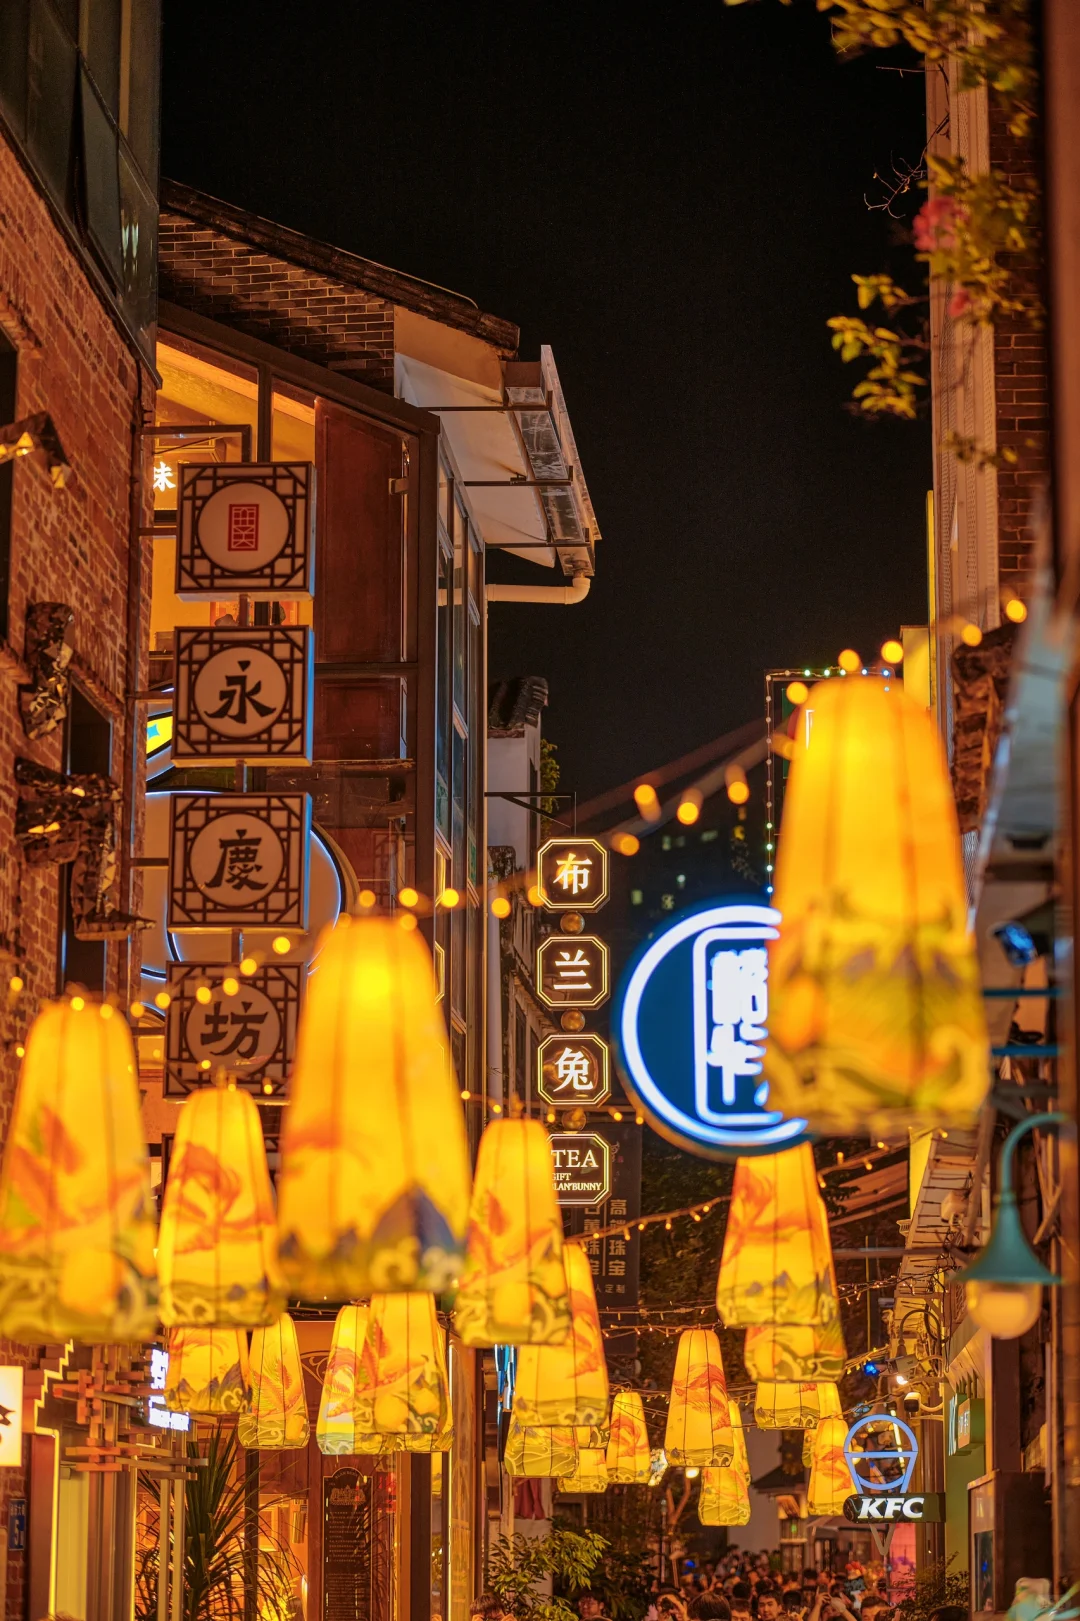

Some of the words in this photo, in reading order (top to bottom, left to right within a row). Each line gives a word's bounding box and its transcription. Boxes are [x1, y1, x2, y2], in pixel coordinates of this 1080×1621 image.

[553, 852, 594, 1093] 布兰兔
[551, 1149, 599, 1168] TEA
[857, 1497, 925, 1519] KFC
